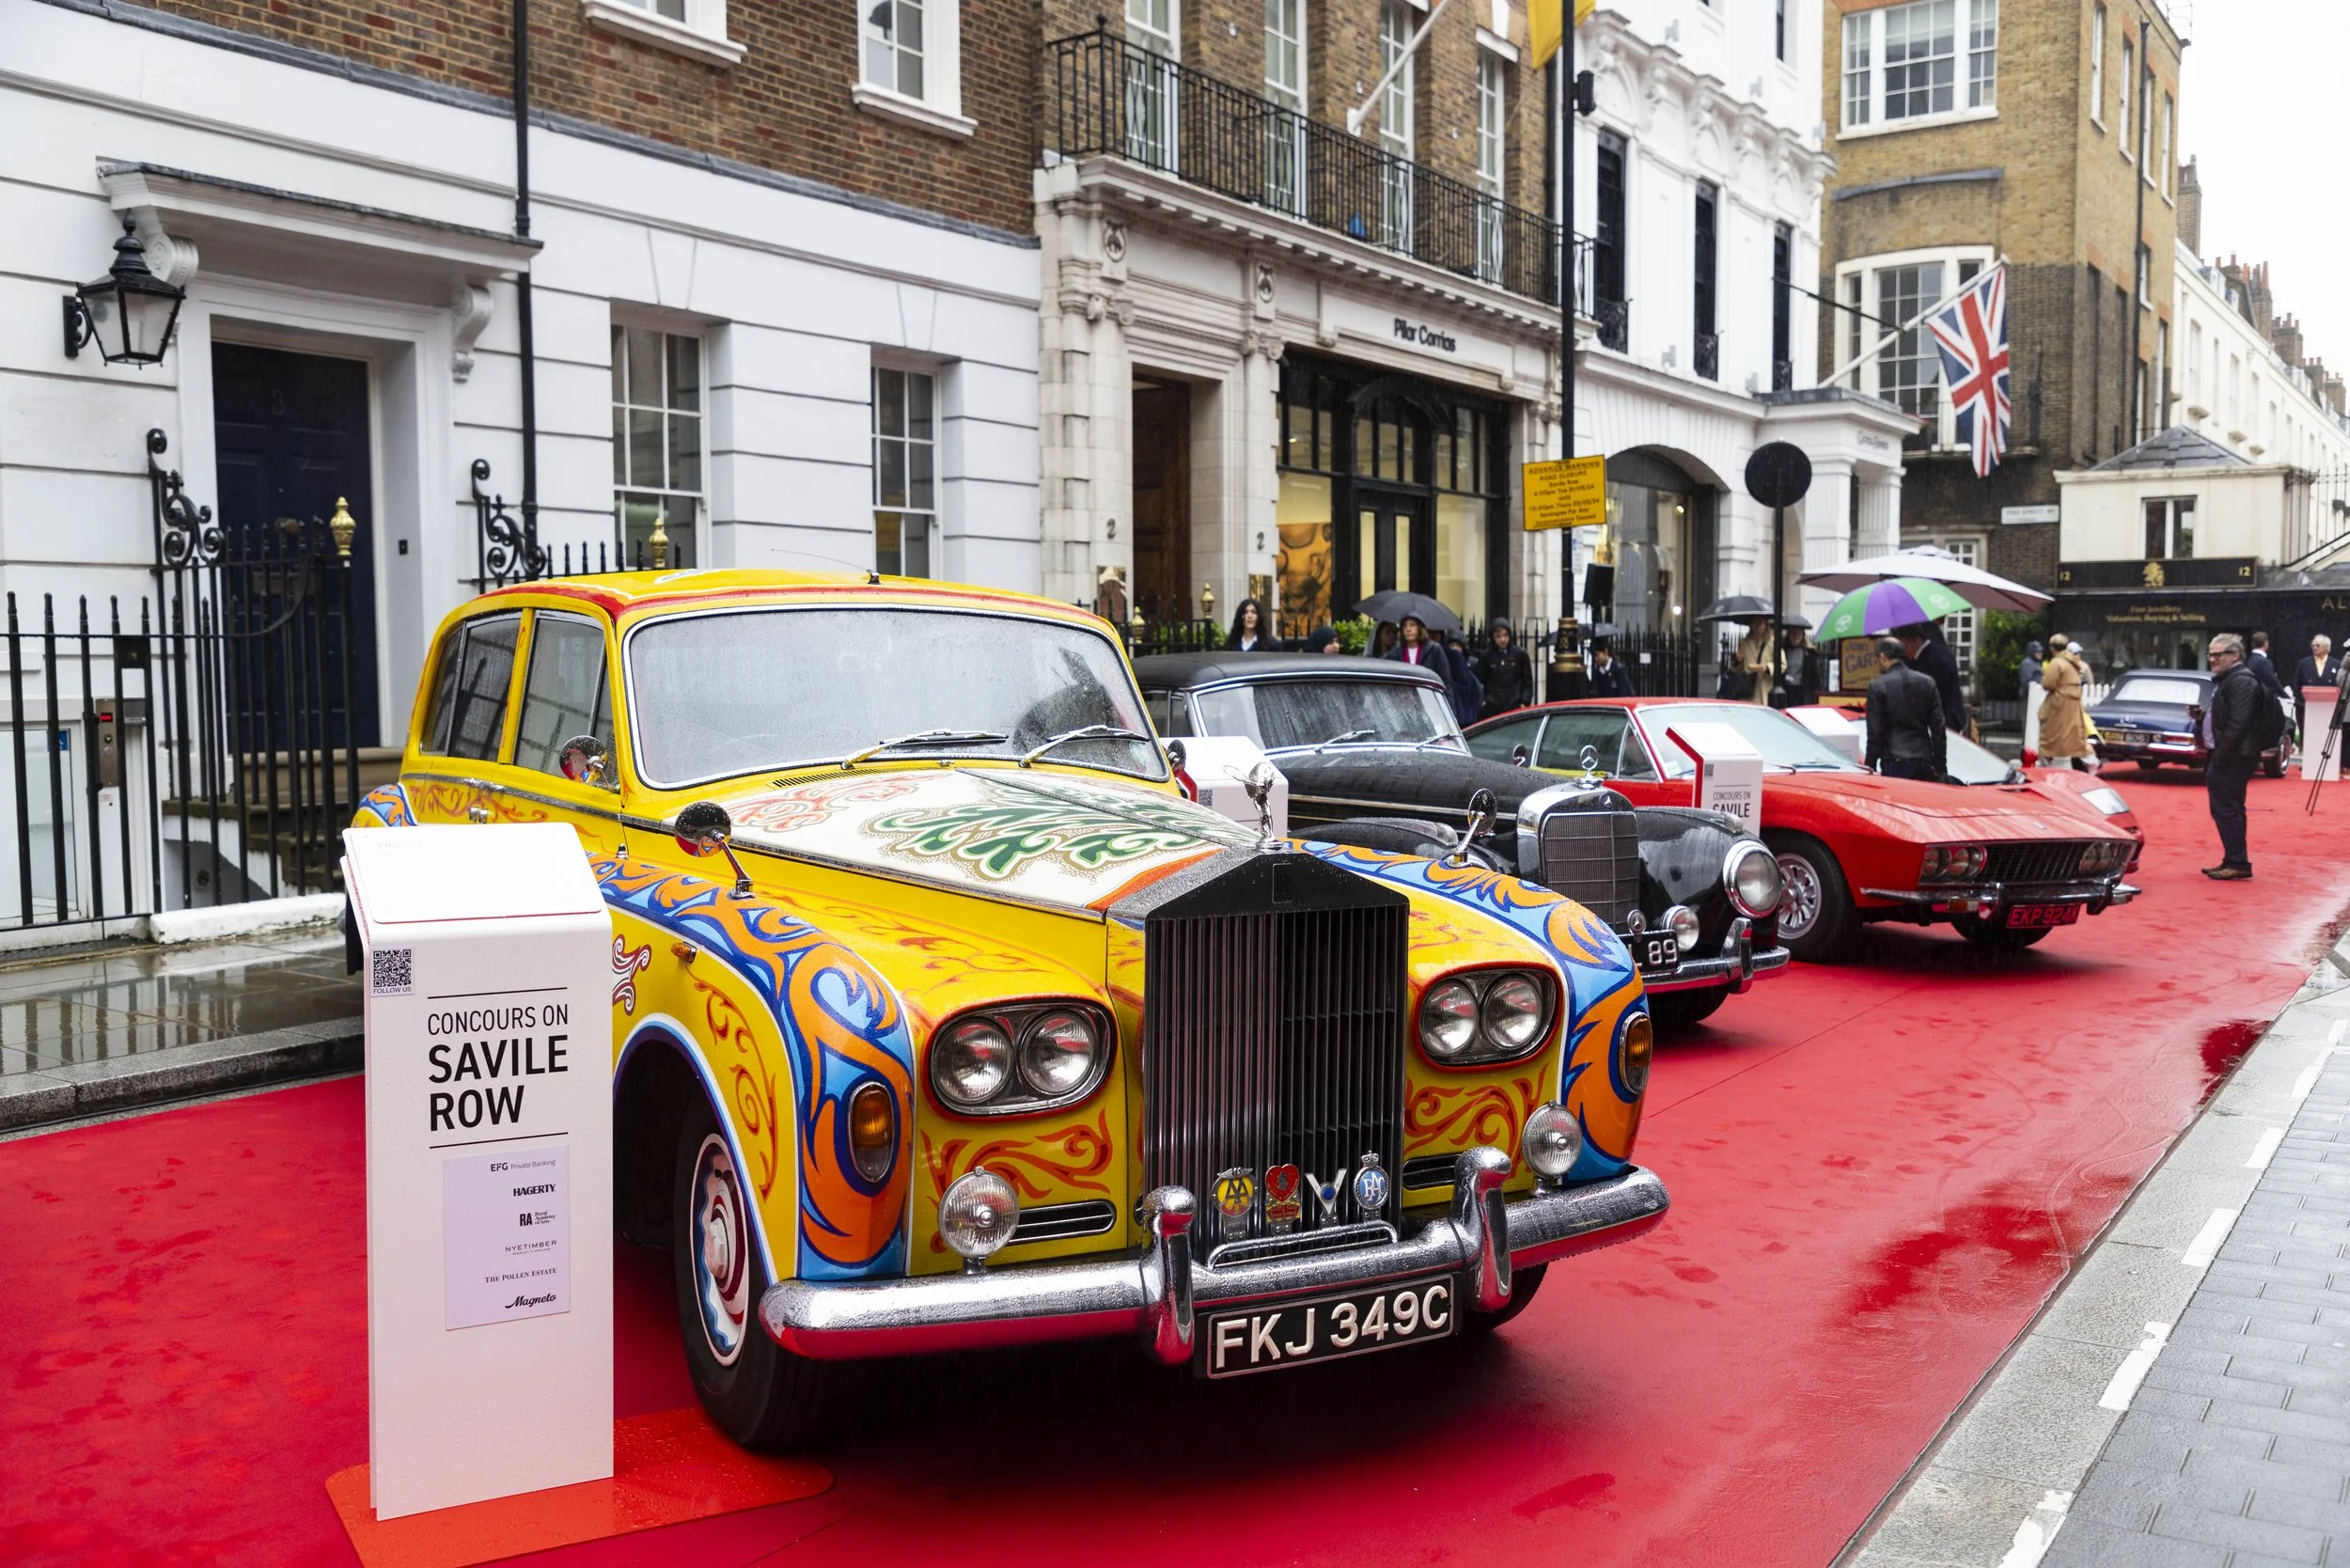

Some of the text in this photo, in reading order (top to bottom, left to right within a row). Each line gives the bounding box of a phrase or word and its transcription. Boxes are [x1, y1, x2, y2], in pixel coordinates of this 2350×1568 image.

[1106, 518, 1116, 540] 2
[1256, 531, 1265, 550] 2
[2060, 571, 2071, 581] 12
[2238, 566, 2250, 576] 12
[1714, 791, 1751, 801] CONCOURS ON
[2010, 907, 2043, 925] EKP
[1648, 939, 1678, 965] 89
[428, 1004, 568, 1035] CONCOURS ON
[429, 1035, 568, 1084] SAVILE
[430, 1085, 525, 1132] ROW
[491, 1162, 509, 1171] EFG
[532, 1159, 556, 1168] Banking
[513, 1184, 556, 1197] HAGERTY
[1363, 1171, 1386, 1201] RAC
[520, 1213, 533, 1226] RA
[505, 1240, 557, 1252] NYETIMBER
[485, 1267, 557, 1283] THE POLLEN ESTATE
[505, 1293, 556, 1309] Magneto
[1216, 1285, 1449, 1369] FKJ 349C
